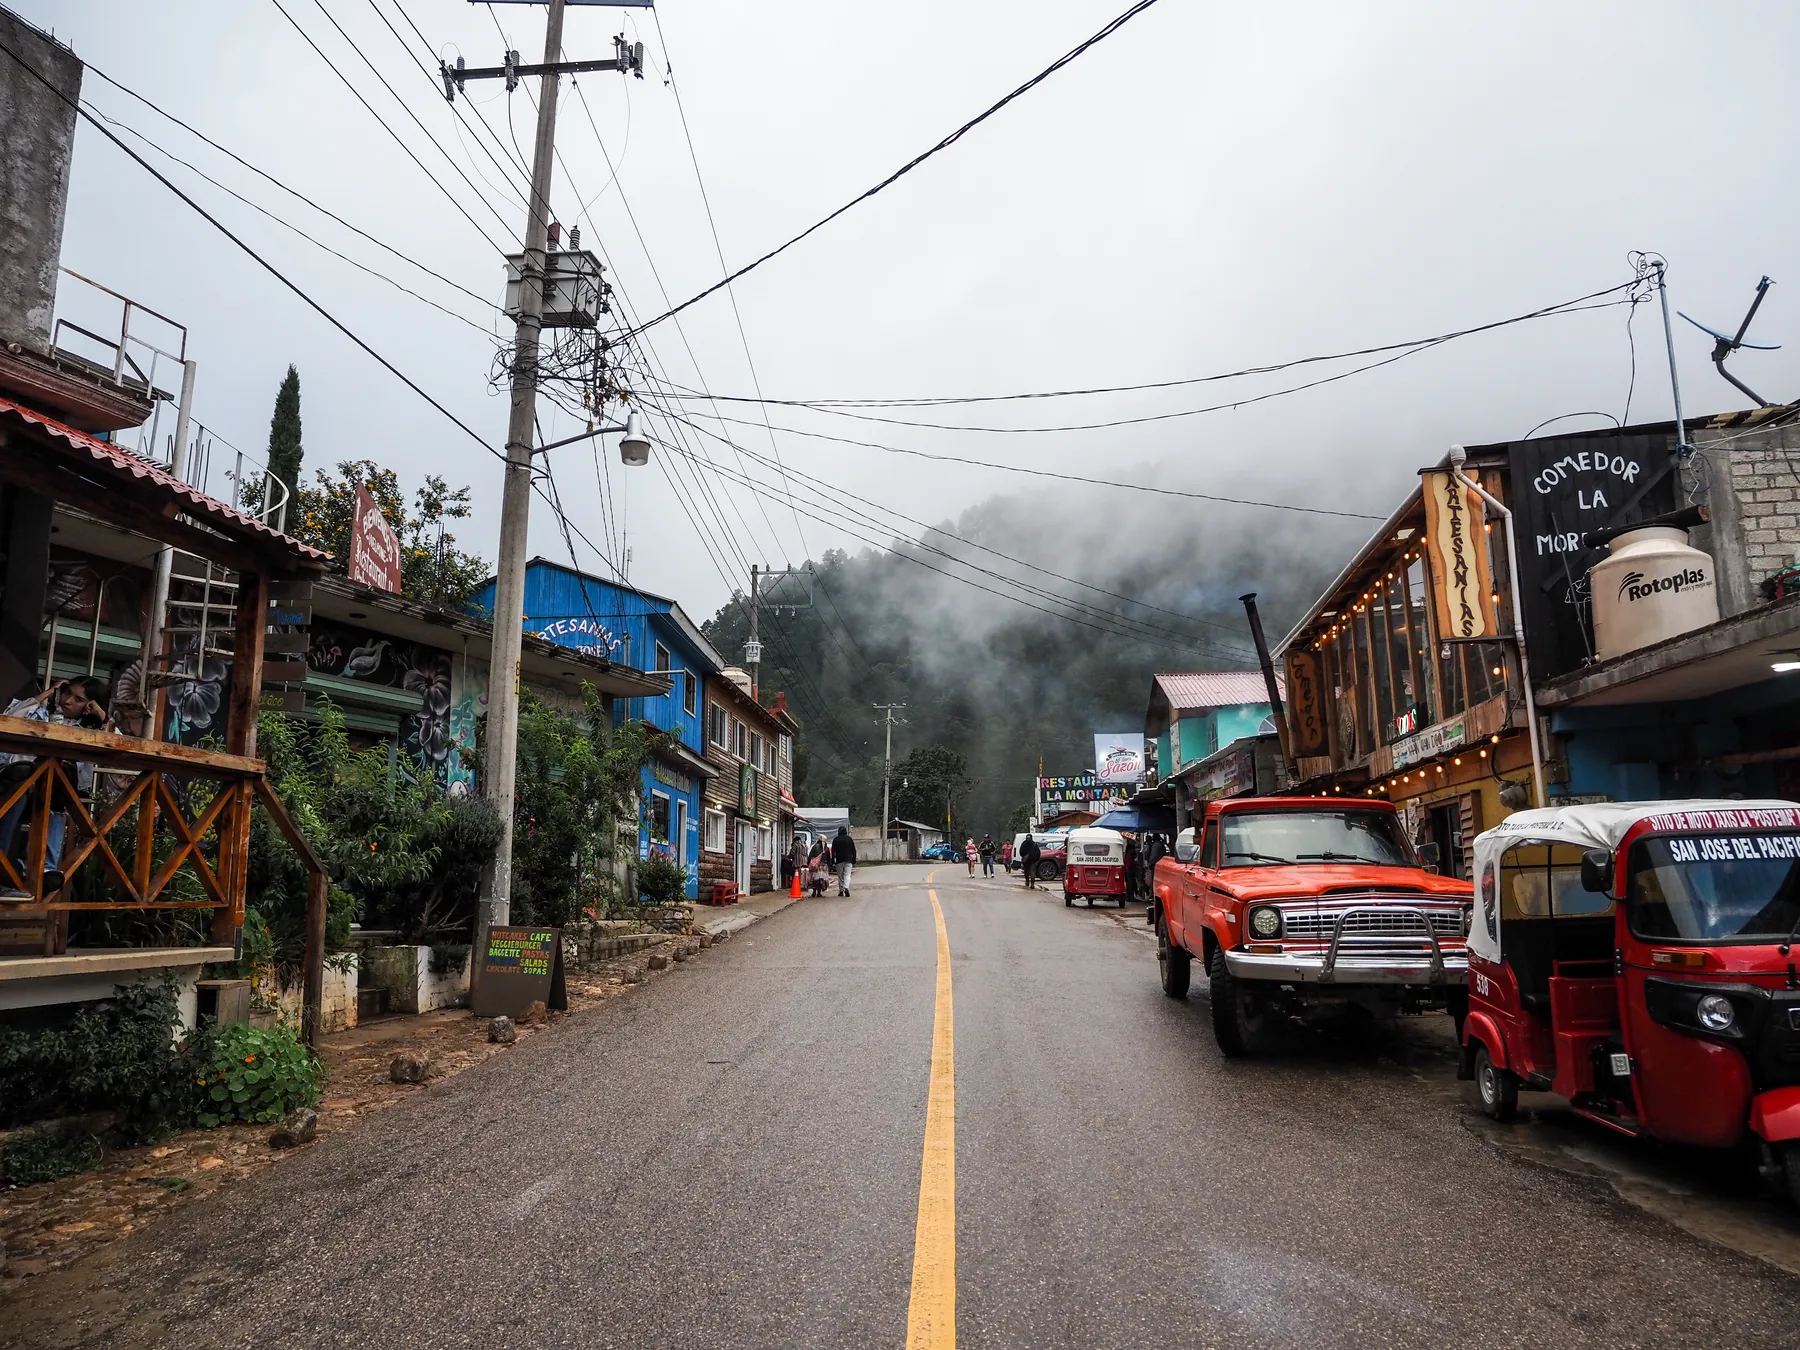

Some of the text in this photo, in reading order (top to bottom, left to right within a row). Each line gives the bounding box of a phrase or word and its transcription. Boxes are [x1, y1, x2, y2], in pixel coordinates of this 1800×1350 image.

[1533, 451, 1640, 494] COMEDOR
[1578, 489, 1609, 510] LA
[1444, 472, 1475, 637] ARTESANIAS
[1628, 568, 1705, 602] Rotoplas
[536, 618, 622, 651] RTESANIAS
[1046, 789, 1063, 801] LA
[1065, 786, 1129, 801] MONTAÑA
[1651, 813, 1675, 831] SITIO
[1672, 812, 1688, 830] DE
[1685, 811, 1713, 830] MOTO
[1710, 810, 1739, 829] TAXIS
[1736, 810, 1751, 828] LA
[1669, 839, 1700, 862] SAN
[1700, 838, 1735, 861] JOSE
[1731, 837, 1761, 859] DEL
[529, 933, 552, 942] CAFE
[519, 958, 549, 968] SALADS
[521, 950, 551, 959] PASTAS
[523, 967, 547, 975] SOPAS
